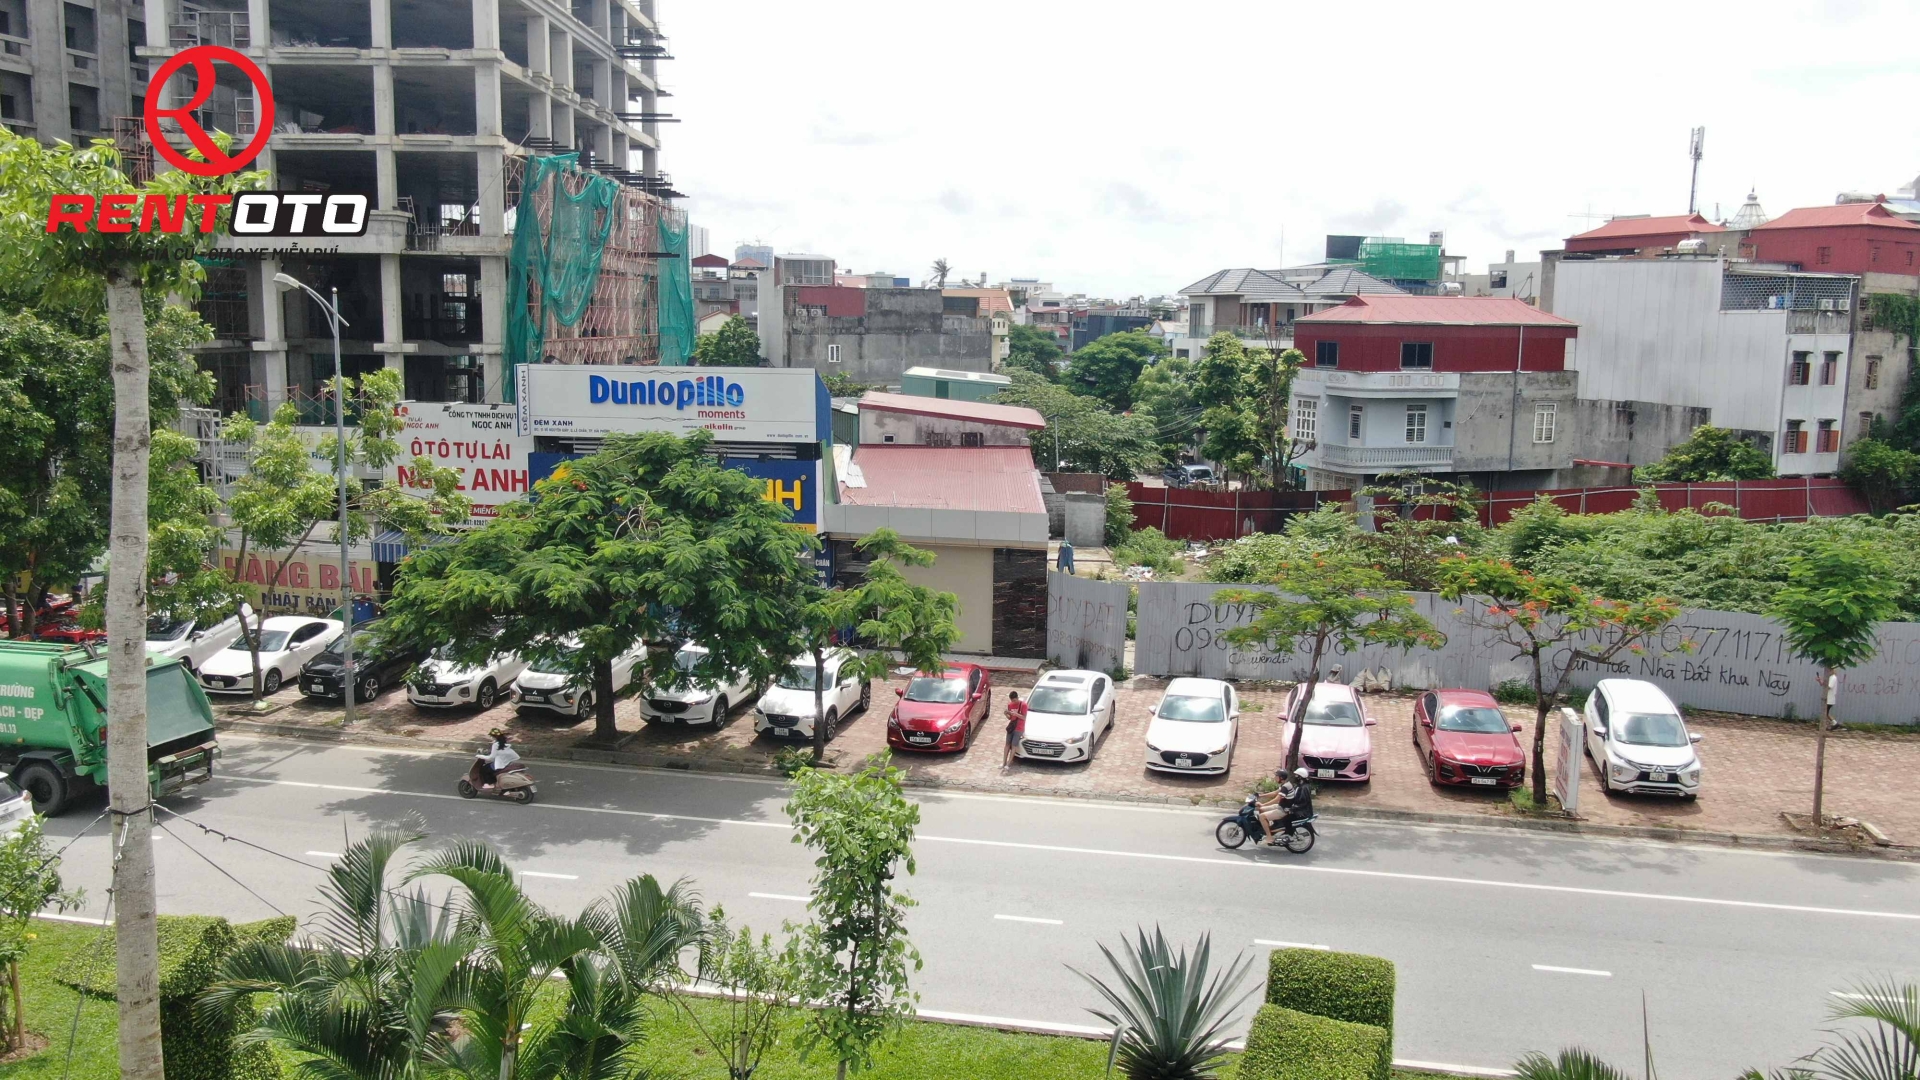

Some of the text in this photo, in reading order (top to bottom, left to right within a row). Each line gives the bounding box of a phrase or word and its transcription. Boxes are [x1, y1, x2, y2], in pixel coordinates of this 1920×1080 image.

[589, 374, 745, 410] Dunlopillo
[448, 410, 465, 419] CÔNG
[466, 411, 474, 419] TY
[698, 410, 746, 419] moments
[472, 421, 512, 431] NGỌC ANH
[481, 439, 510, 460] LÁI
[471, 468, 528, 492] ANH
[225, 553, 372, 594] HÀNG BÃI
[24, 707, 45, 722] ĐẸP
